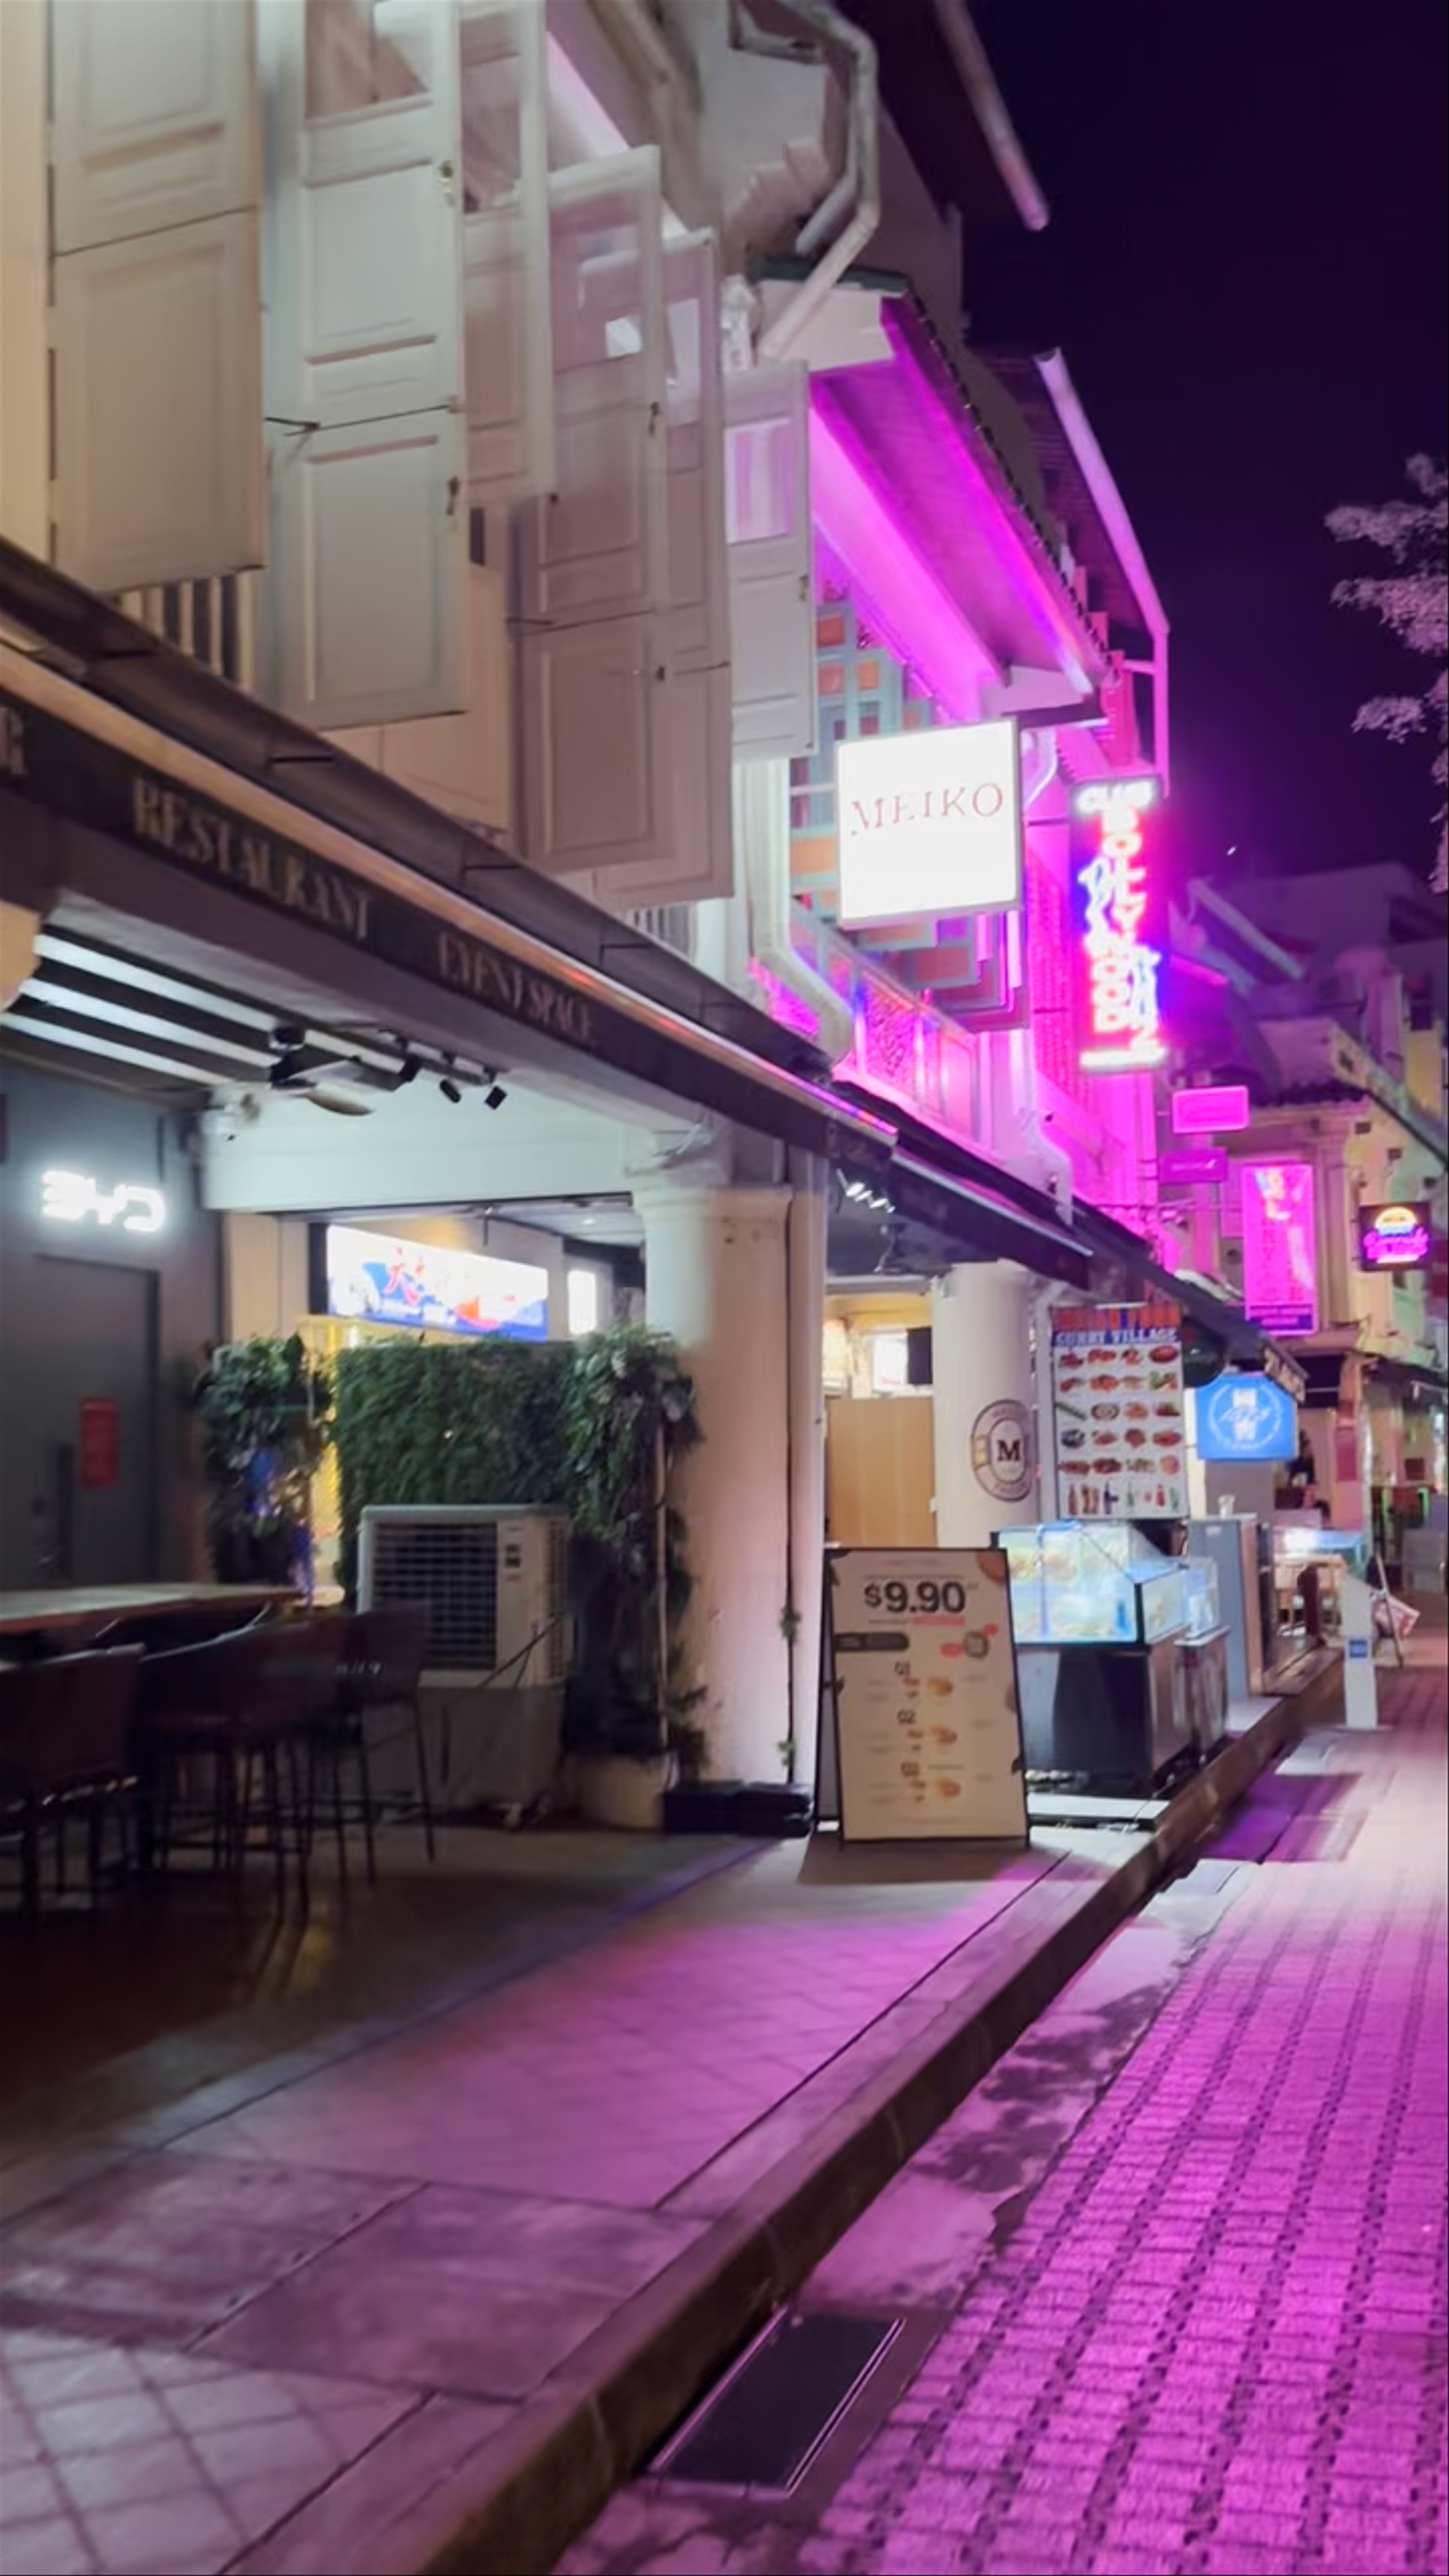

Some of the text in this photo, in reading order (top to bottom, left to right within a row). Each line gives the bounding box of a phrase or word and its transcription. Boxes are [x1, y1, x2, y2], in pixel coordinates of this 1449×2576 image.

[851, 783, 1004, 835] MEIKO
[133, 774, 369, 940] RESTAURANT
[1108, 1327, 1179, 1345] VILLAGE
[997, 1439, 1020, 1461] M
[864, 1581, 966, 1613] $9.90
